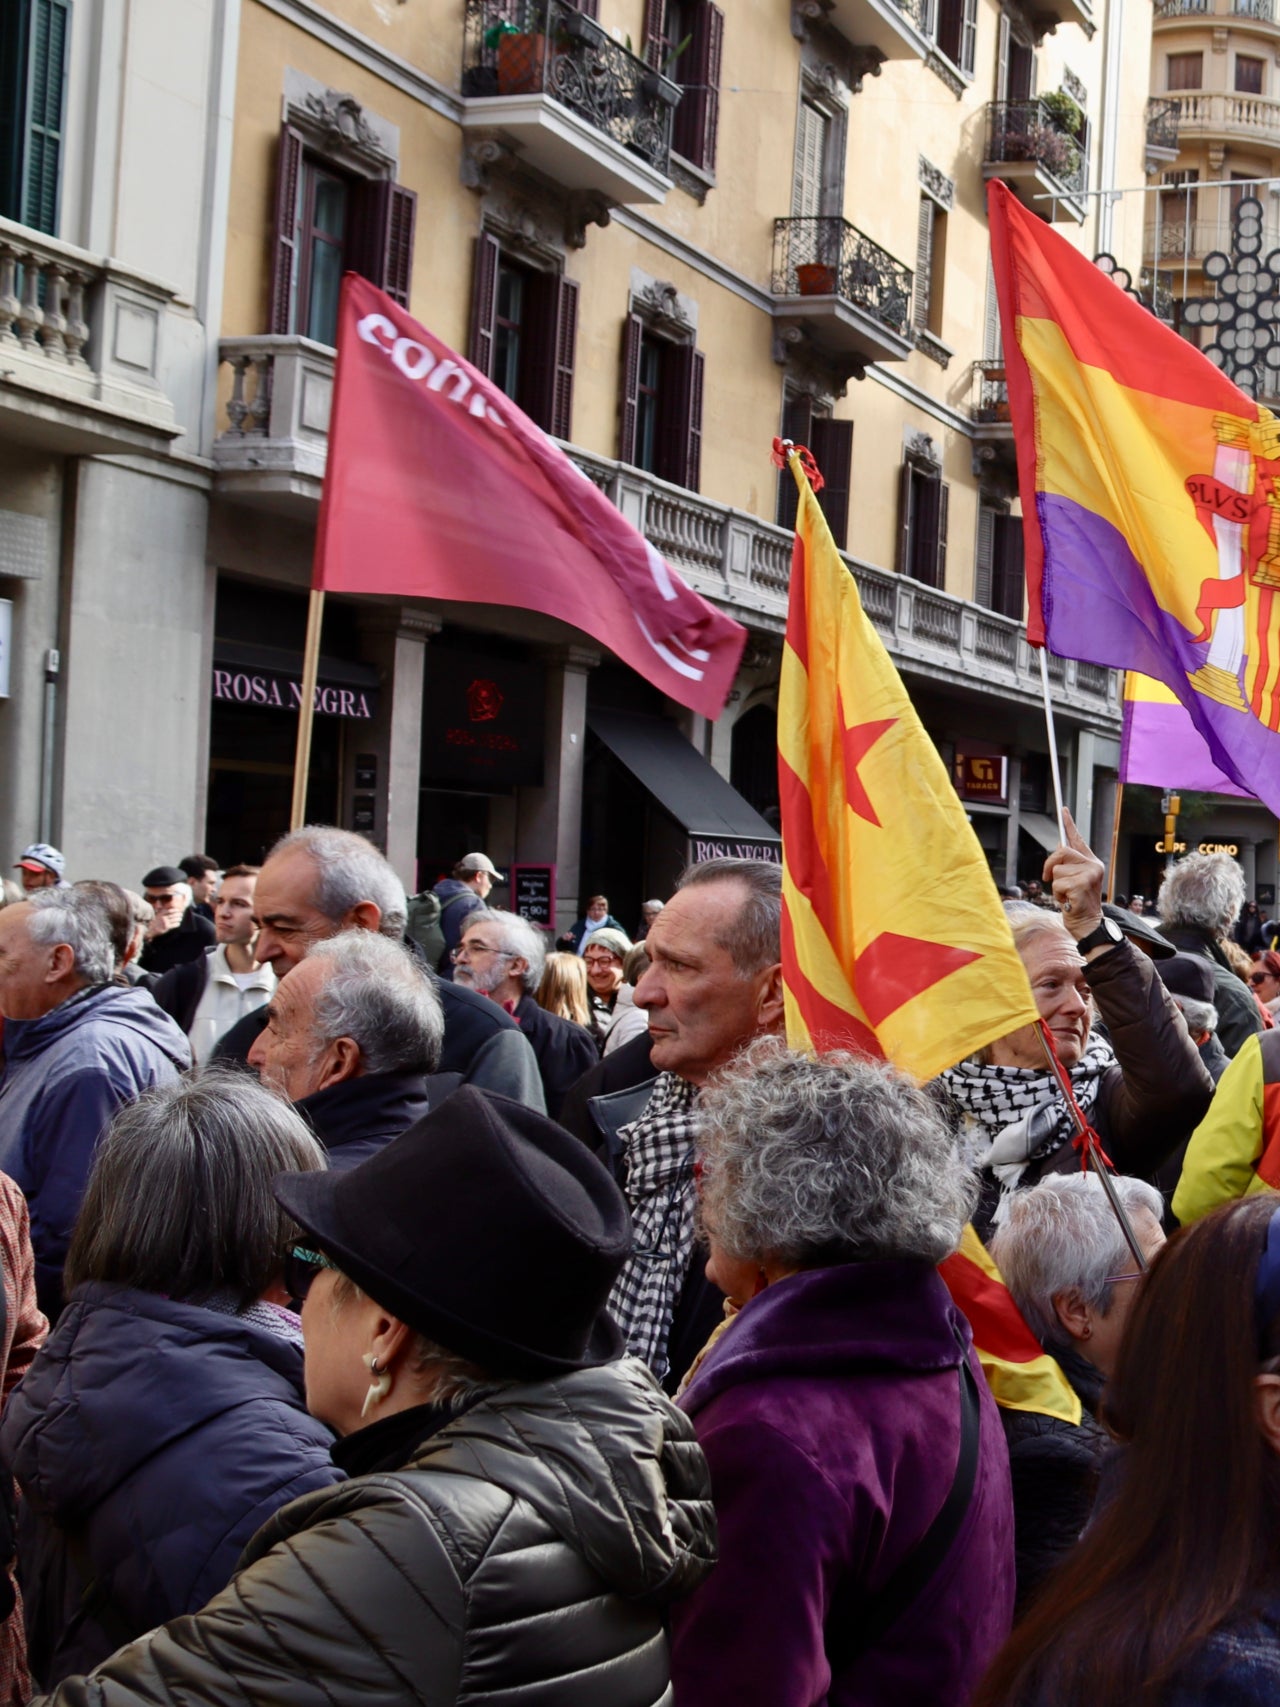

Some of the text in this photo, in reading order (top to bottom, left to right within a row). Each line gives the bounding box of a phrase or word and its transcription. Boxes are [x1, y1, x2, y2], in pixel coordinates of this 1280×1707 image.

[1187, 482, 1248, 518] PLVS
[214, 670, 283, 706] ROSA
[696, 841, 780, 864] ROSA NEGRA
